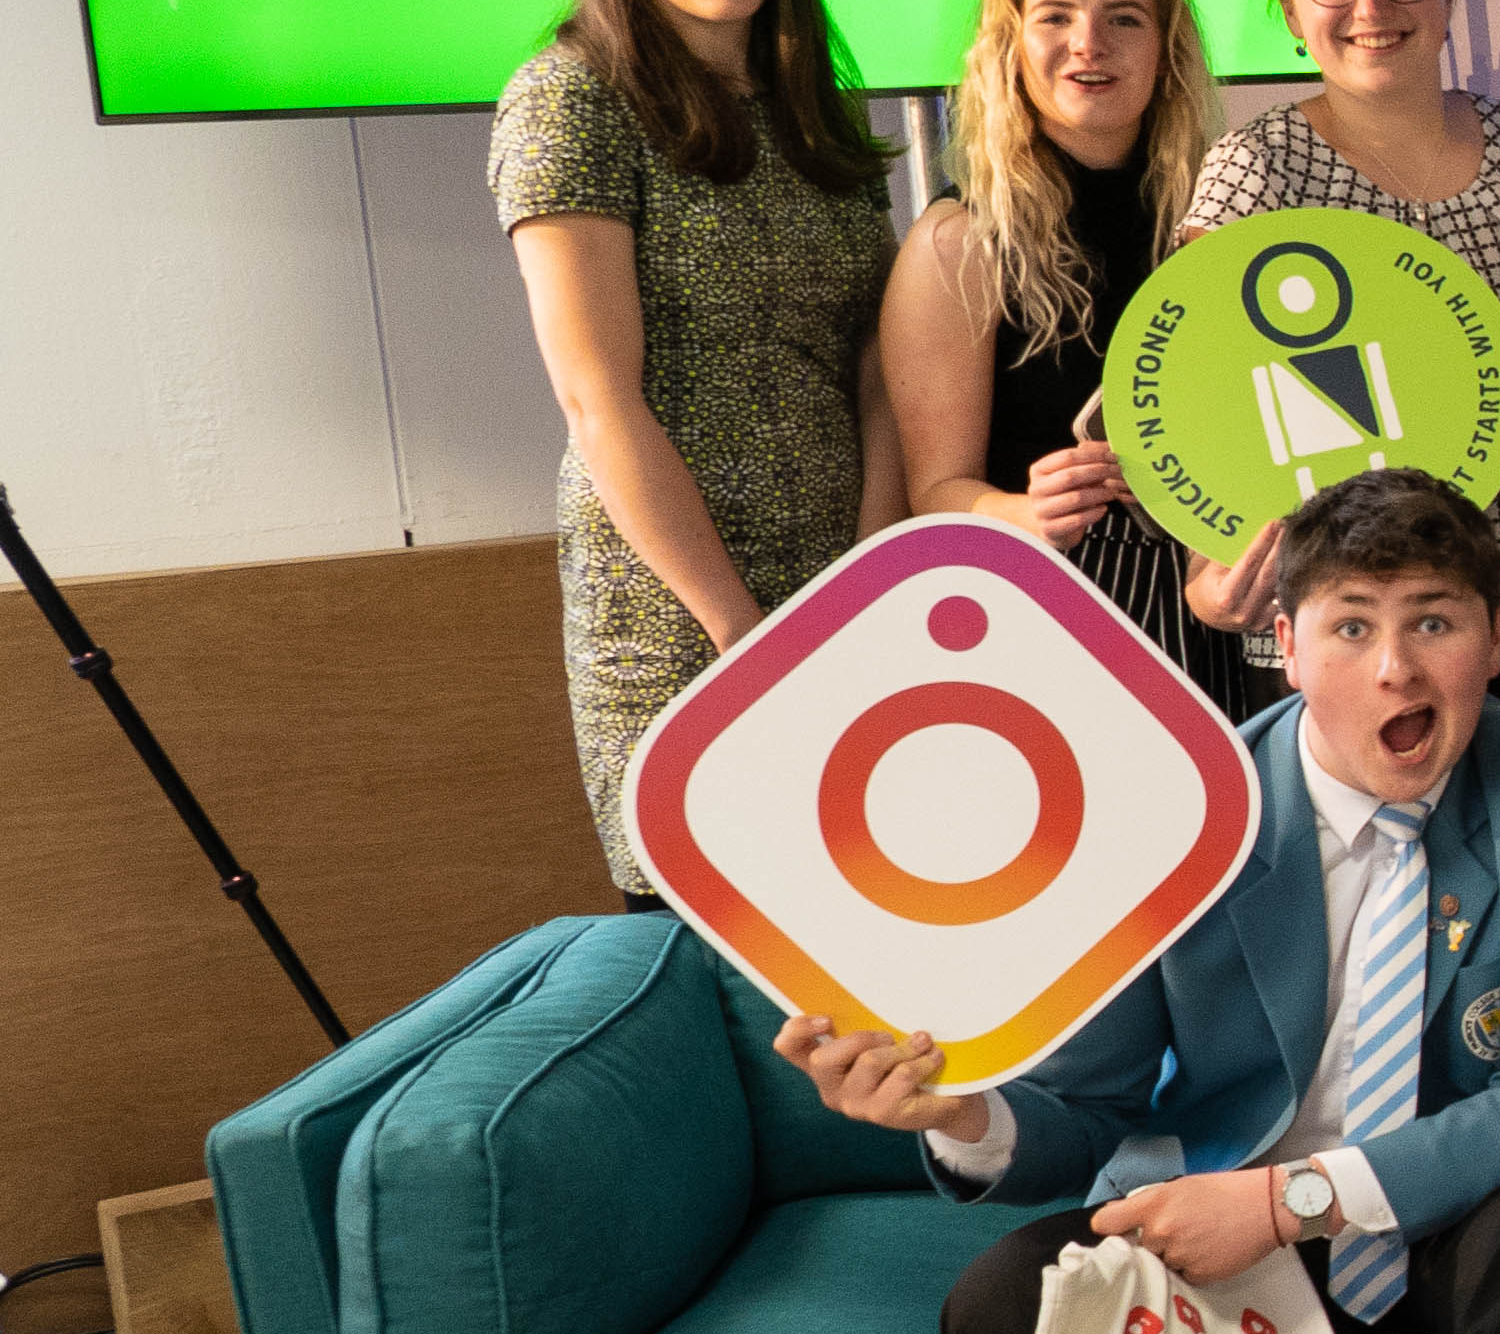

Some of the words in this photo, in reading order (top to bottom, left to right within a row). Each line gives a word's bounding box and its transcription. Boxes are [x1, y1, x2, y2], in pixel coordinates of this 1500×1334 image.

[1394, 251, 1448, 294] YOU
[1133, 298, 1187, 409] STONES
[1445, 293, 1495, 357] WITH
[1467, 366, 1500, 462] STARTS
[1152, 453, 1245, 538] STICKS
